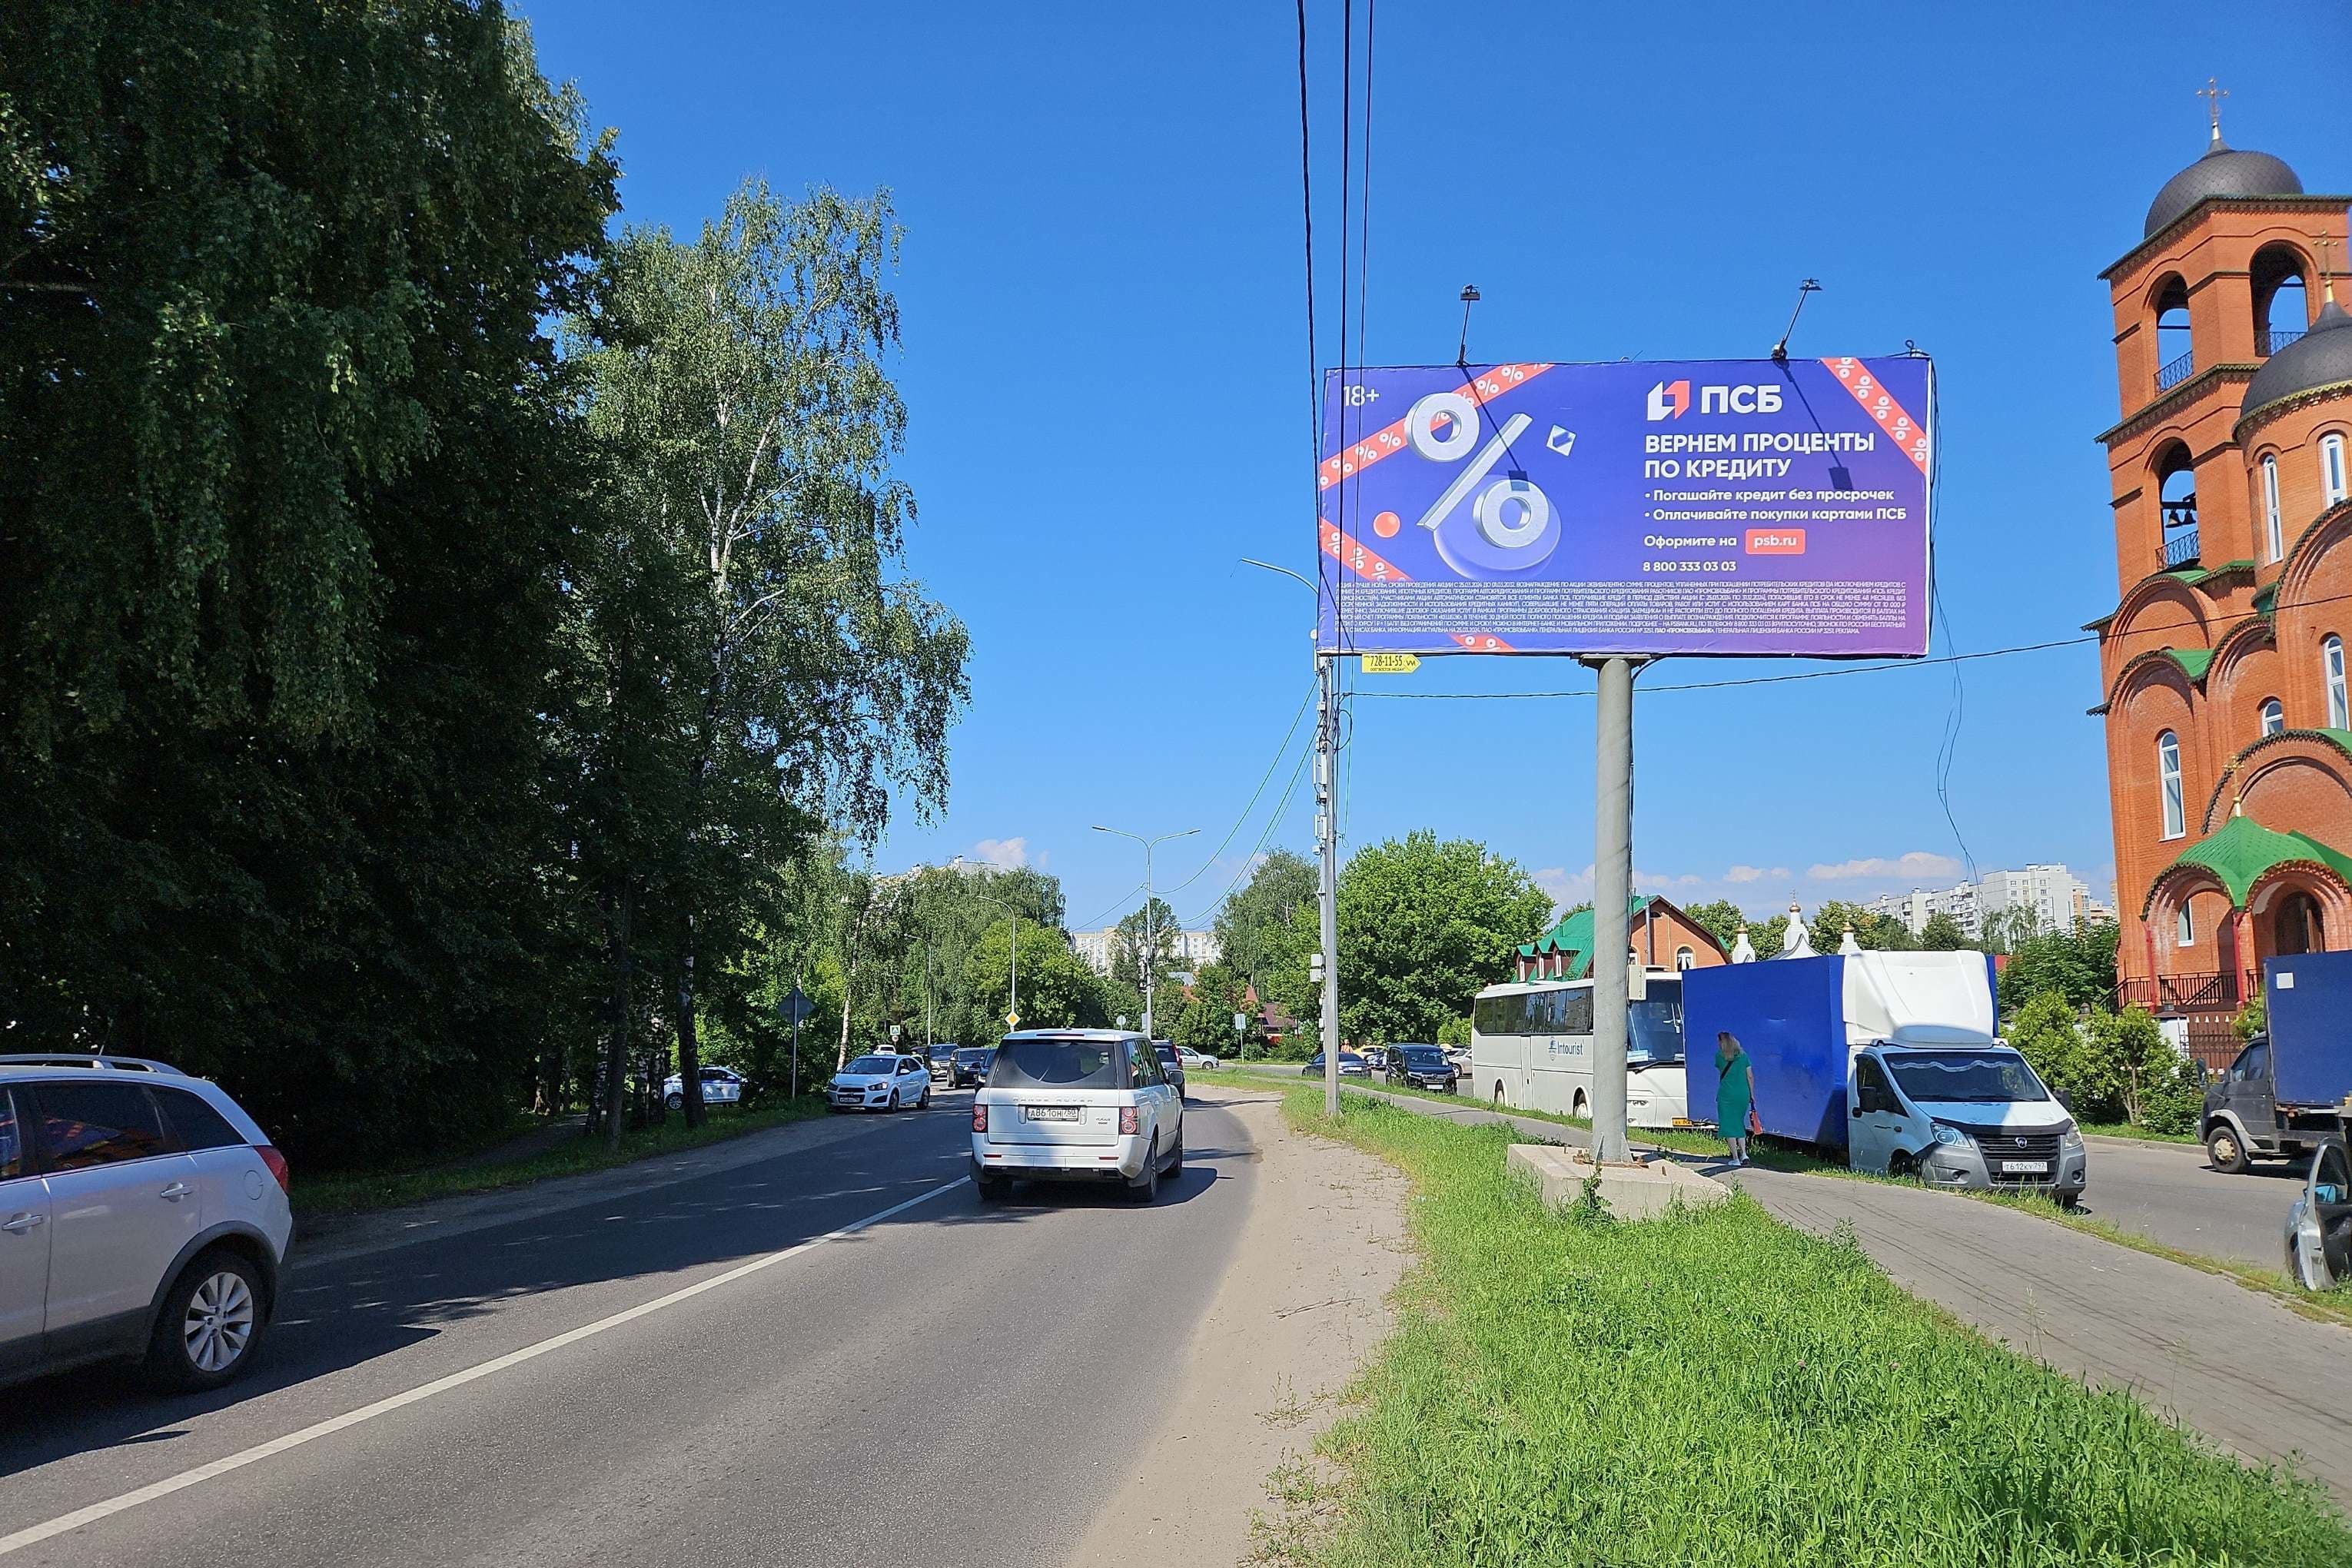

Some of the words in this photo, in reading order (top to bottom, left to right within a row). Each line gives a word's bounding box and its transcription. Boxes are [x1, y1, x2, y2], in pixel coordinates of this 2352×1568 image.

[1343, 385, 1380, 407] 18+
[1700, 384, 1783, 414] ПСБ
[1645, 434, 1737, 453] ВЕРНЕМ
[1743, 432, 1875, 455] ПРОЦЕНТЫ
[1644, 460, 1680, 479] ПО
[1686, 458, 1792, 480] КРЕДИТУ
[1653, 489, 1733, 501] Погашайте
[1736, 490, 1786, 503] кредит
[1789, 489, 1813, 500] без
[1816, 490, 1895, 503] просрочек
[1653, 508, 1748, 521] Оплачивайте
[1751, 510, 1809, 523] покупки
[1812, 510, 1873, 523] картами
[1876, 507, 1907, 520] ПСБ
[1644, 535, 1716, 550] Оформите
[1719, 537, 1738, 546] на
[1754, 534, 1797, 549] psb.ru
[1643, 561, 1651, 572] 8
[1653, 561, 1677, 572] 800
[1679, 561, 1701, 572] 333
[1703, 561, 1719, 572] 03
[1721, 561, 1737, 572] 03
[1557, 1041, 1583, 1055] Intourist
